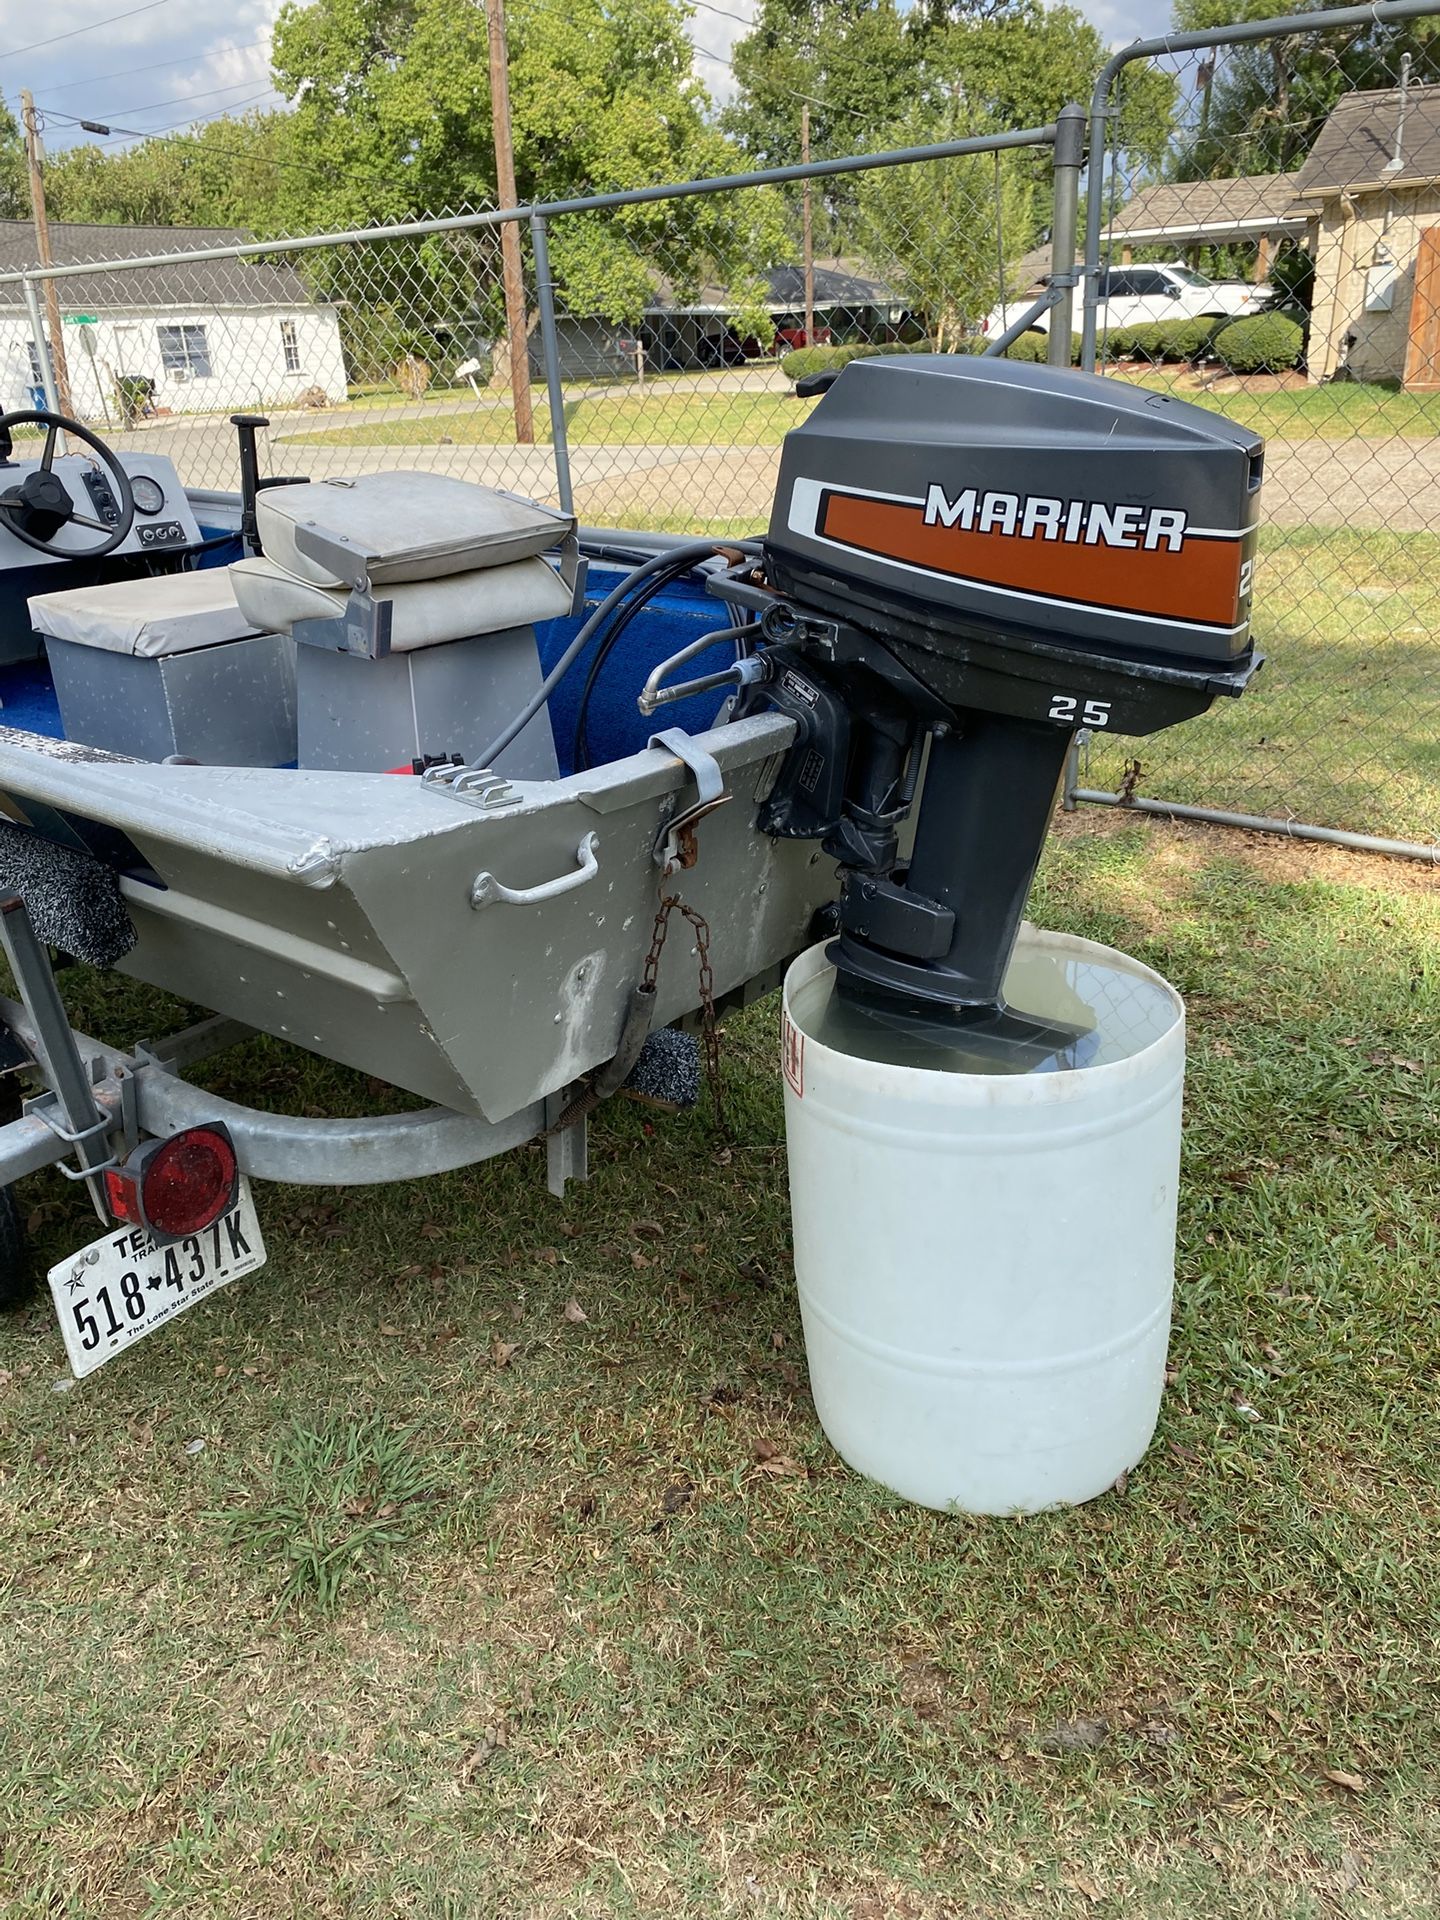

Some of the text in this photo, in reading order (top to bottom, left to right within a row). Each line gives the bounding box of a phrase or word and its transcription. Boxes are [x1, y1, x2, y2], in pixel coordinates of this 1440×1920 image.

[924, 484, 1188, 552] MARINER
[1048, 695, 1112, 727] 25
[127, 1280, 214, 1337] The Lone Star State
